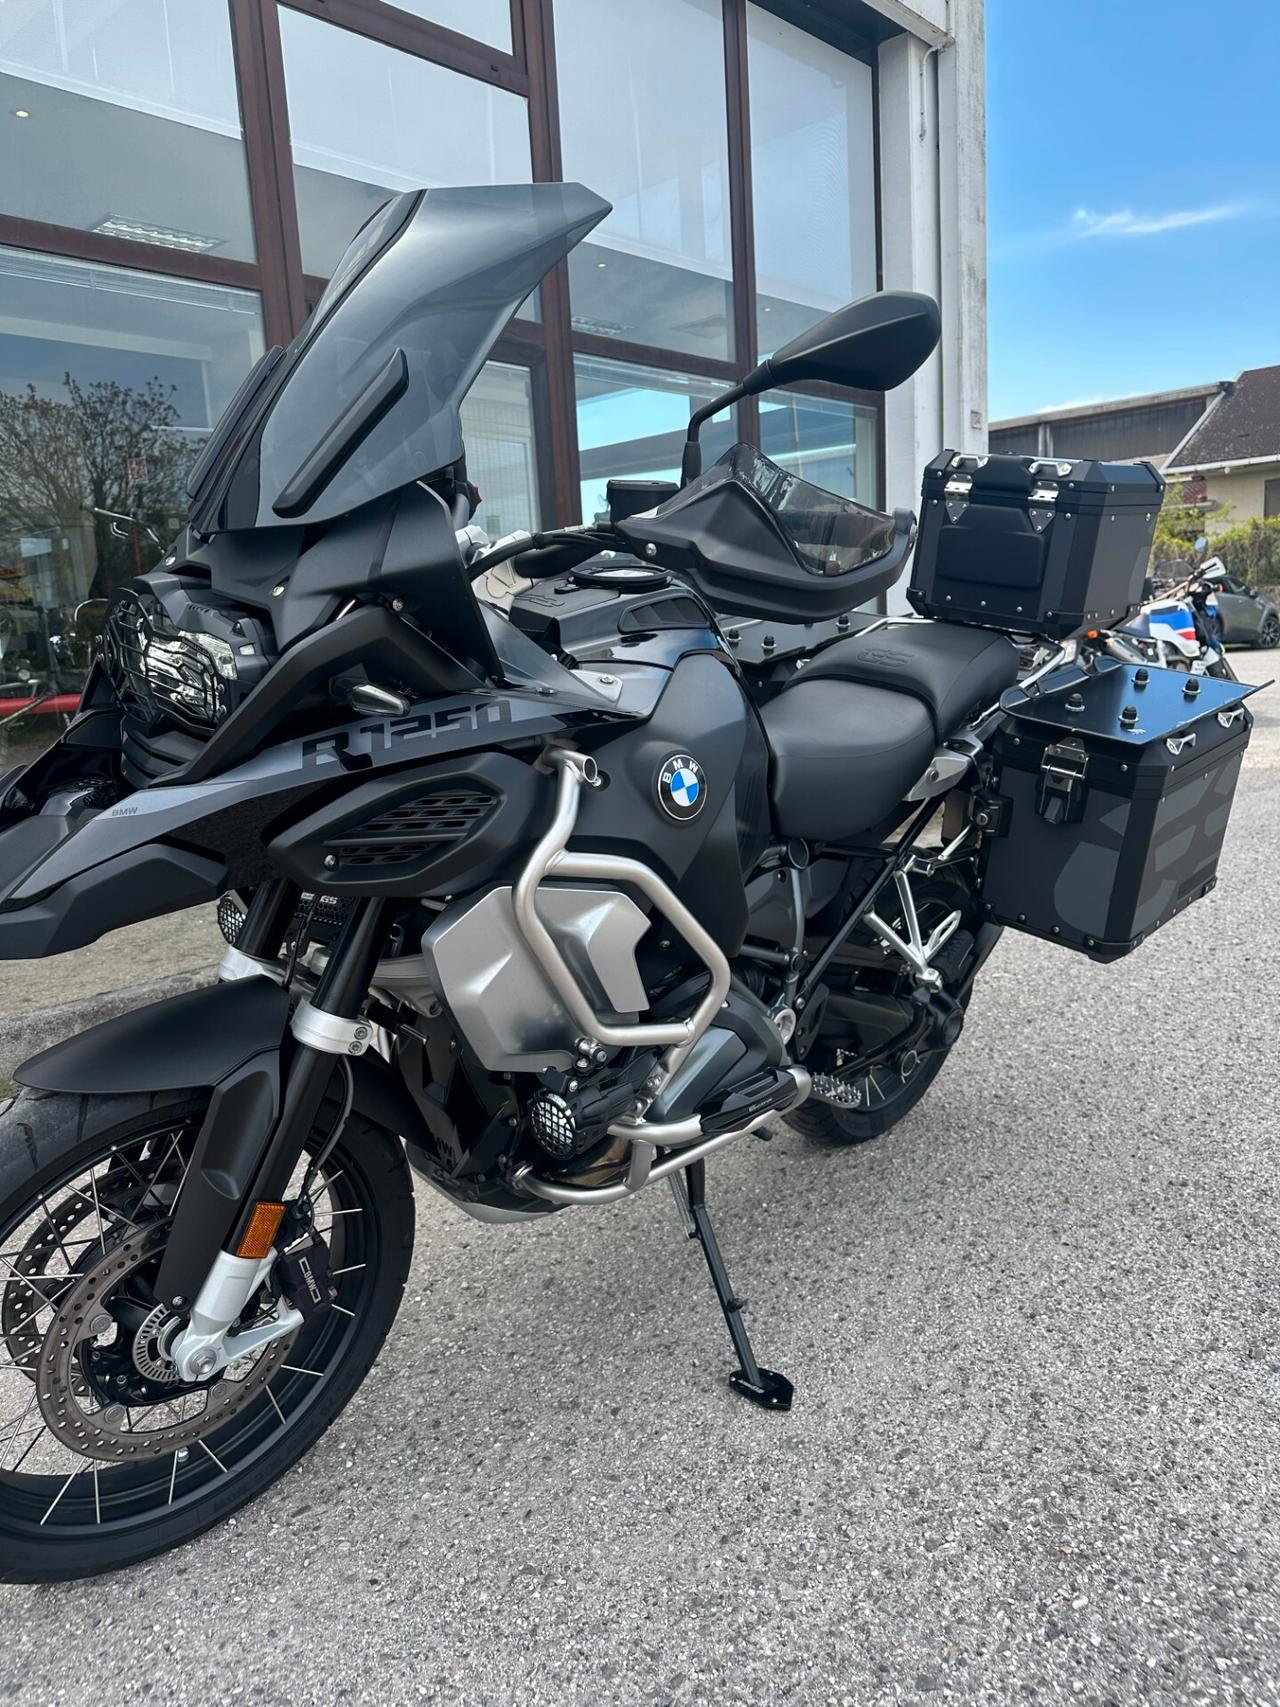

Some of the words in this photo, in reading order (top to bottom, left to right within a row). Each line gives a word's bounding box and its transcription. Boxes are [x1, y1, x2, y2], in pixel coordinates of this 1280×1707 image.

[662, 758, 699, 784] BMW
[112, 807, 138, 817] BMW
[319, 894, 339, 905] GS
